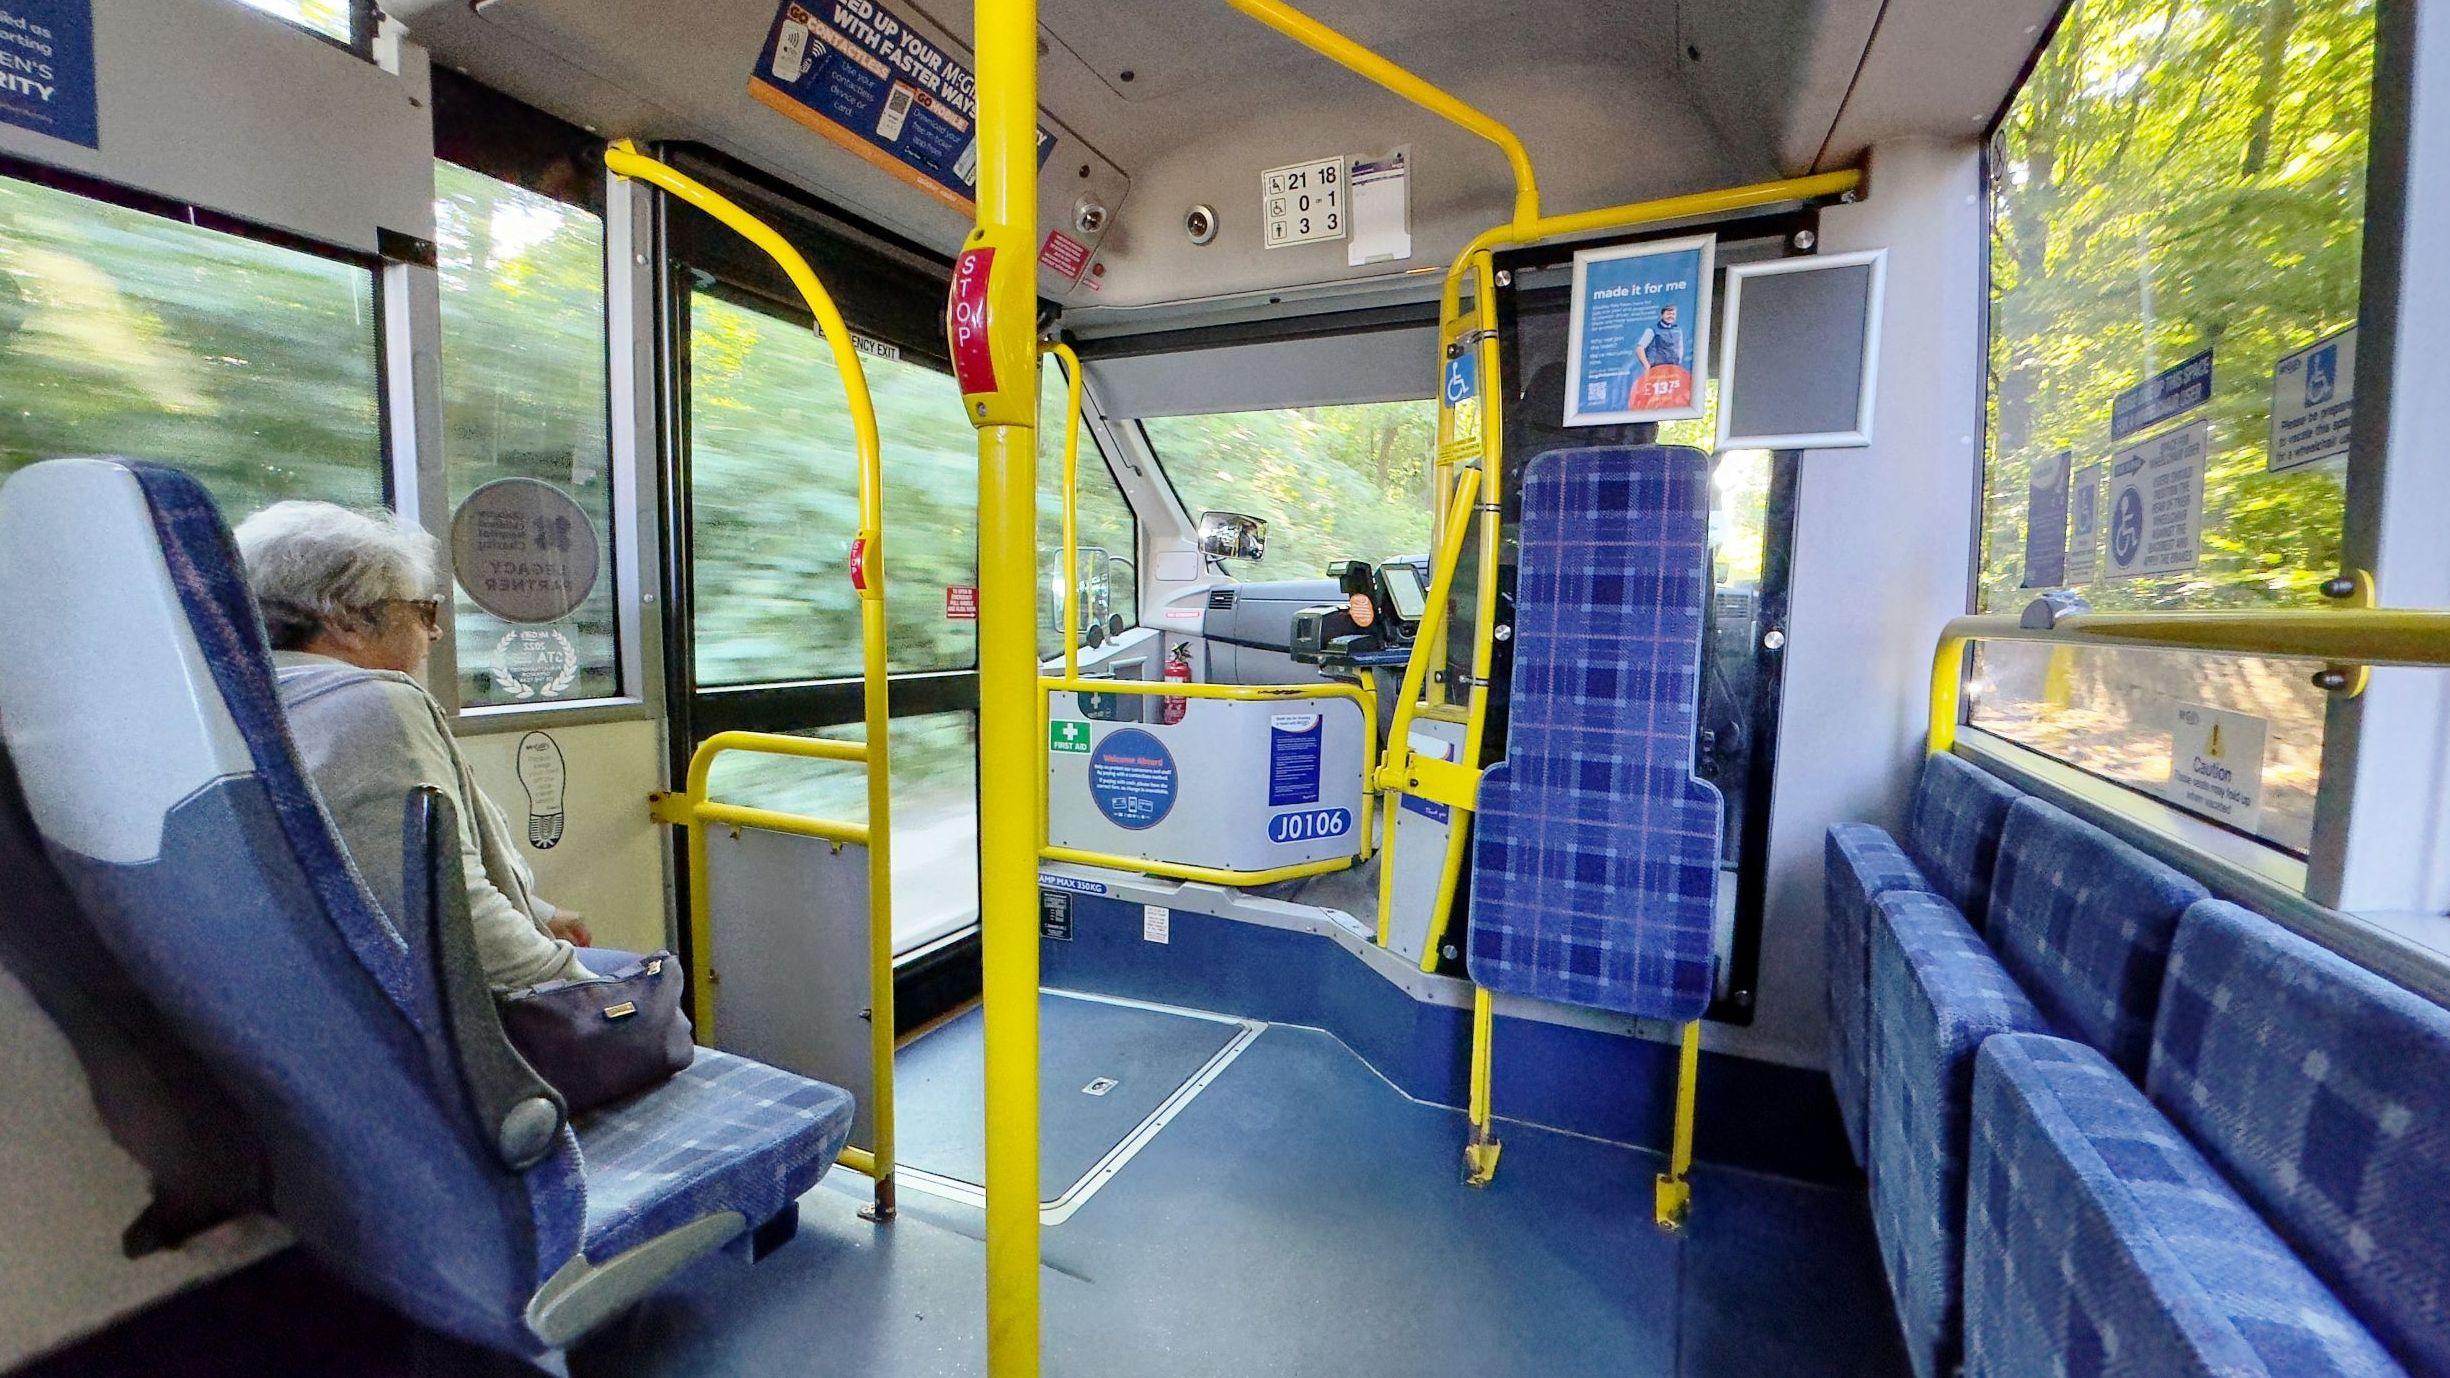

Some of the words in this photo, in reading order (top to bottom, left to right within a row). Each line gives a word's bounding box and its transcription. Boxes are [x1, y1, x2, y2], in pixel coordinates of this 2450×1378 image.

[791, 6, 809, 25] GO
[834, 4, 881, 50] WITH
[880, 39, 940, 92] FASTER
[874, 11, 899, 36] UP
[900, 30, 942, 71] YOUR
[917, 92, 933, 107] GO
[1288, 172, 1307, 190] 21
[1318, 166, 1336, 185] 18
[1299, 195, 1310, 212] 0
[1328, 190, 1336, 207] 1
[1299, 218, 1310, 234] 3
[1327, 213, 1338, 230] 3
[956, 254, 978, 348] STOP
[1593, 286, 1630, 300] made
[1631, 284, 1642, 296] it
[1645, 282, 1664, 295] for
[1666, 280, 1687, 292] me
[877, 343, 896, 359] EXIT
[850, 541, 860, 574] STOP
[1054, 741, 1074, 750] FIRST
[2193, 756, 2232, 782] Caution
[1277, 812, 1344, 840] J0106
[1039, 875, 1056, 883] AMP
[1056, 877, 1076, 888] MAX
[1077, 881, 1103, 893] 350KG
